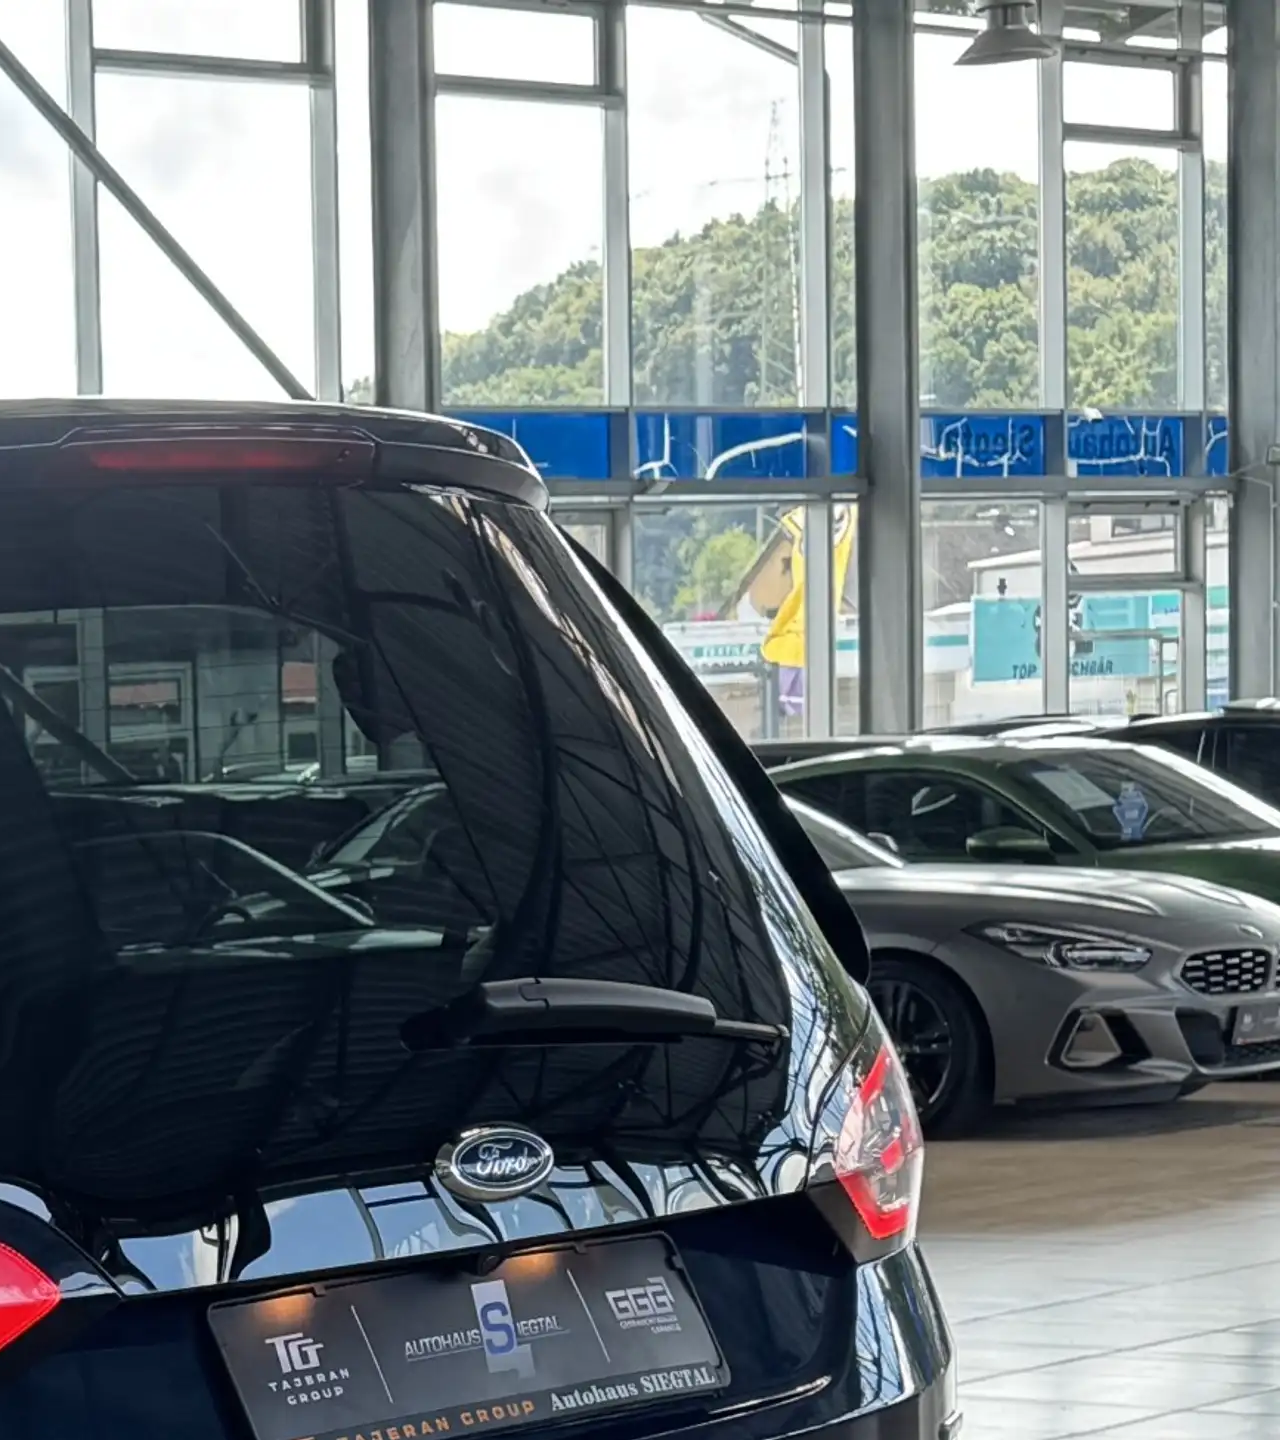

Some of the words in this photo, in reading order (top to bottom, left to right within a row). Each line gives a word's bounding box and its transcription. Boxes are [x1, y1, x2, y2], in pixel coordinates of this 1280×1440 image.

[1012, 664, 1038, 680] TOP
[476, 1141, 533, 1176] Ford
[265, 1332, 324, 1374] TG
[405, 1329, 482, 1356] AUTOHAUS
[287, 1386, 344, 1405] GROUP
[460, 1399, 536, 1427] GROUP
[550, 1378, 638, 1412] Autohaus
[640, 1365, 716, 1394] SIEGTAL
